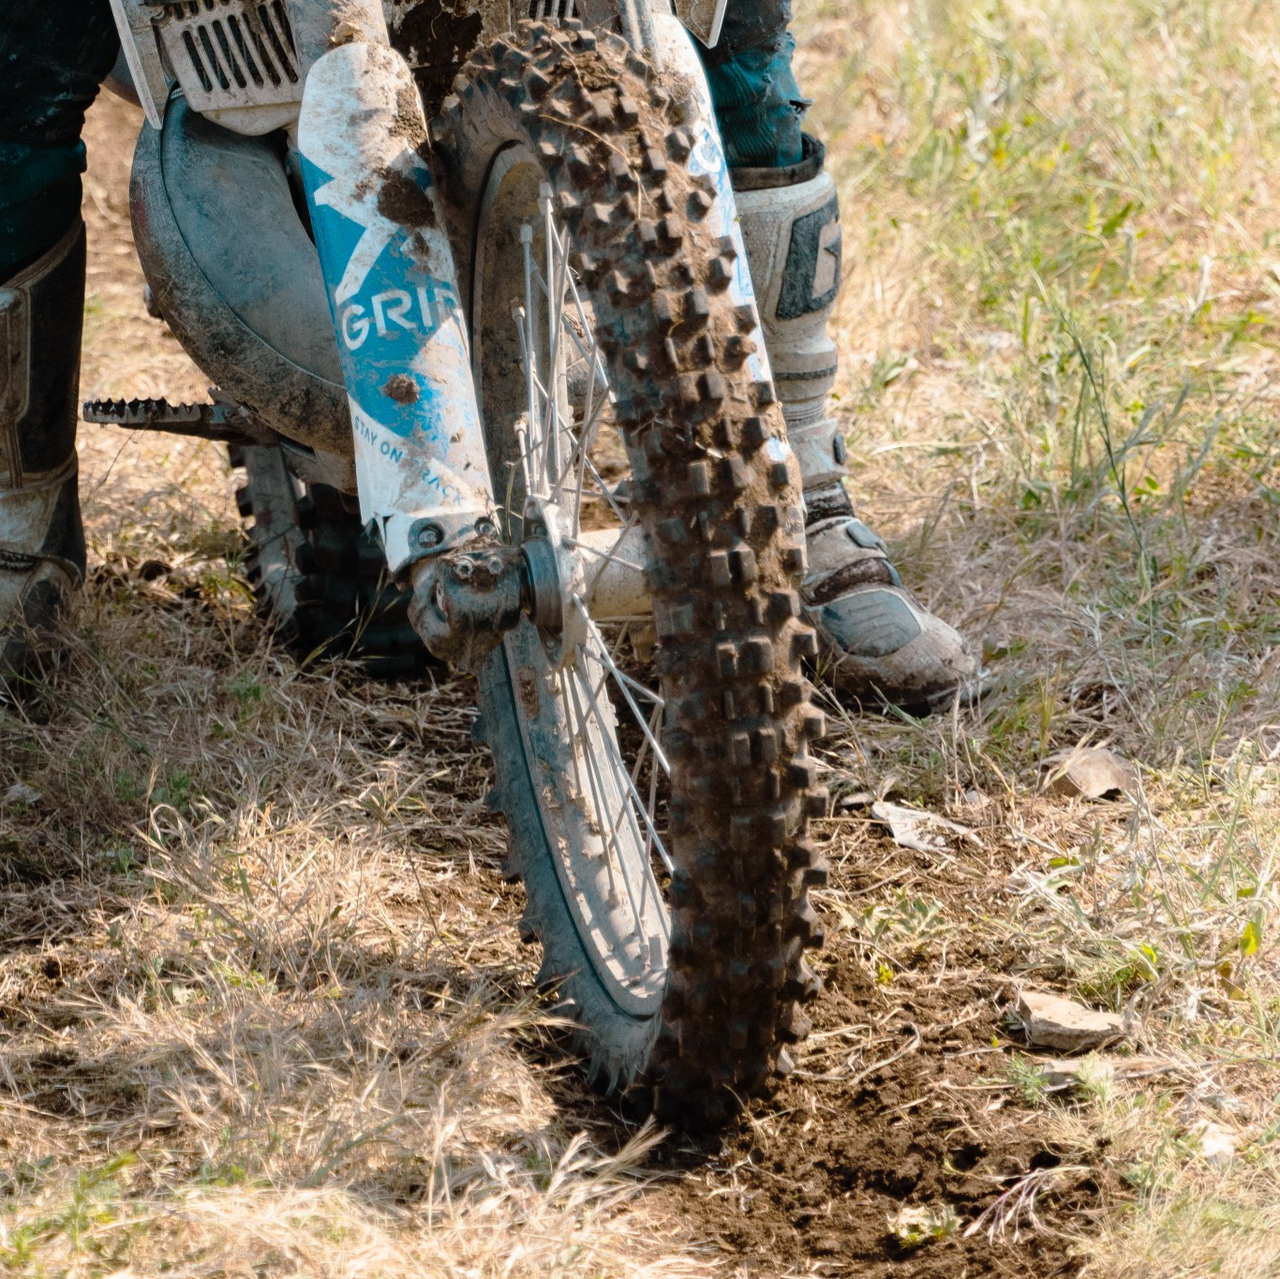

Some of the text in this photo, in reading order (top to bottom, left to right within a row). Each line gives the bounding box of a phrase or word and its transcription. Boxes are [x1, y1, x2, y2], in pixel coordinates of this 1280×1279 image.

[353, 416, 464, 508] STAY ON RACK
